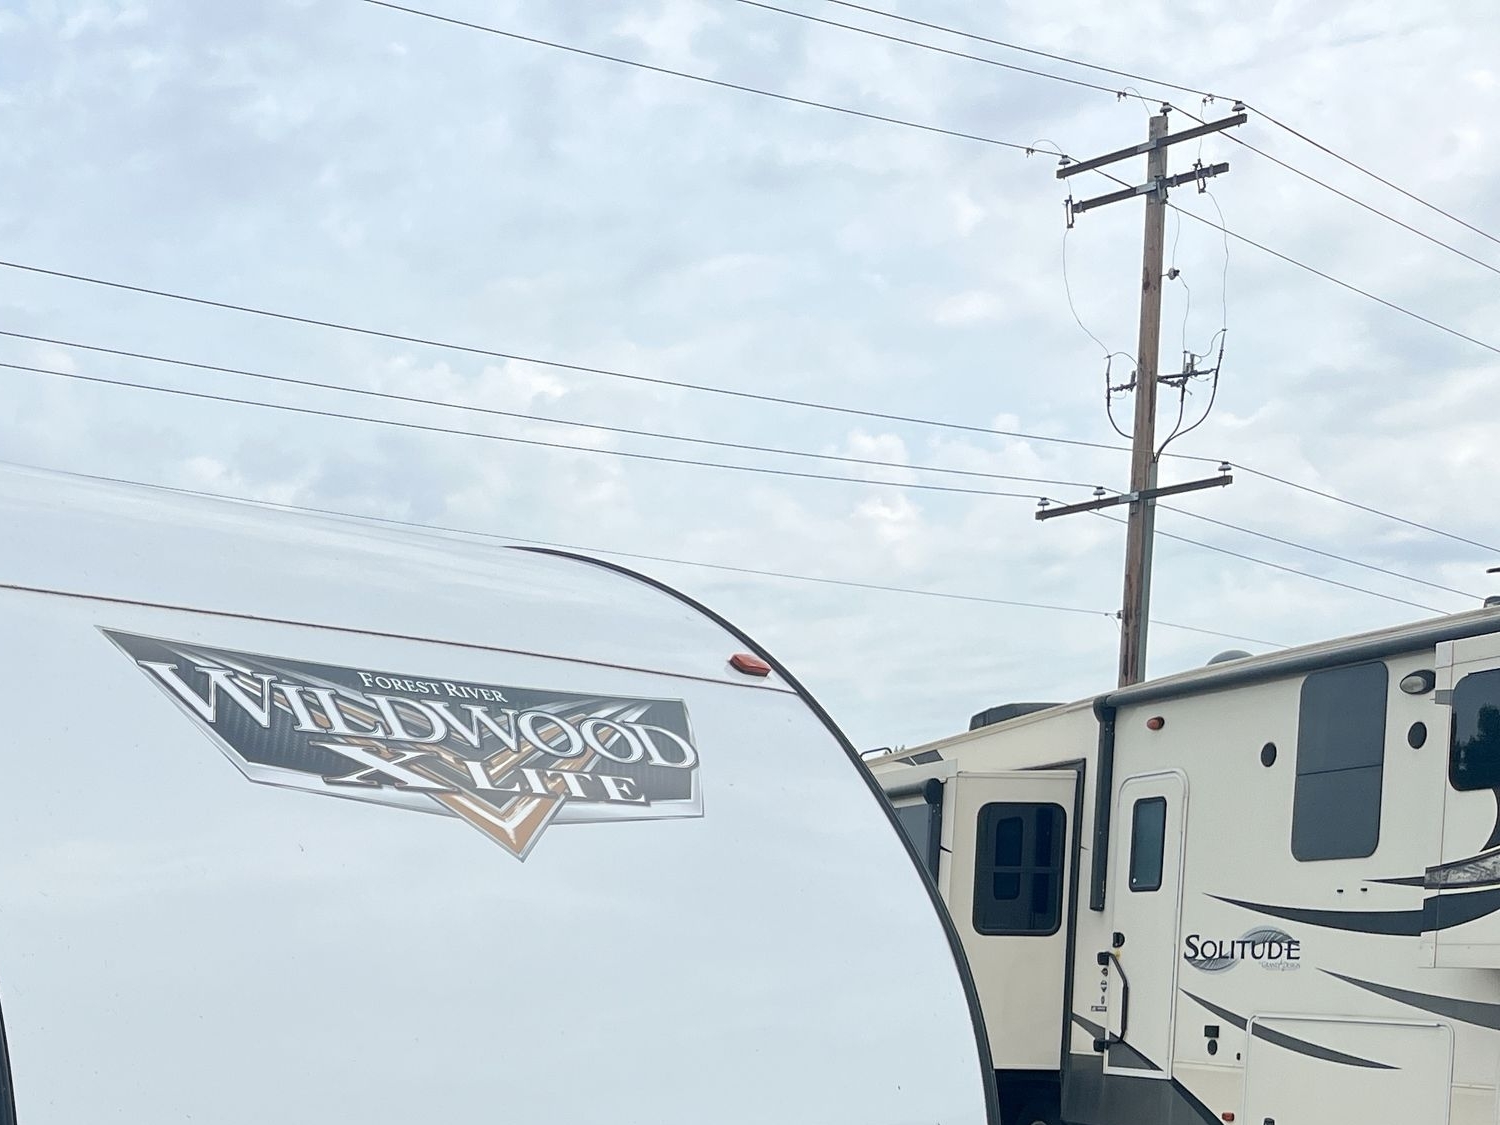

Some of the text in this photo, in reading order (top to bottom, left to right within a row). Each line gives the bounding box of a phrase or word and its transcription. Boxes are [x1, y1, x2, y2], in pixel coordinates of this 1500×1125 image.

[358, 671, 509, 704] FOREST RIVER
[135, 657, 700, 770] WILDWOOD
[309, 739, 648, 805] X LITE
[1183, 933, 1301, 961] SOLITUDE
